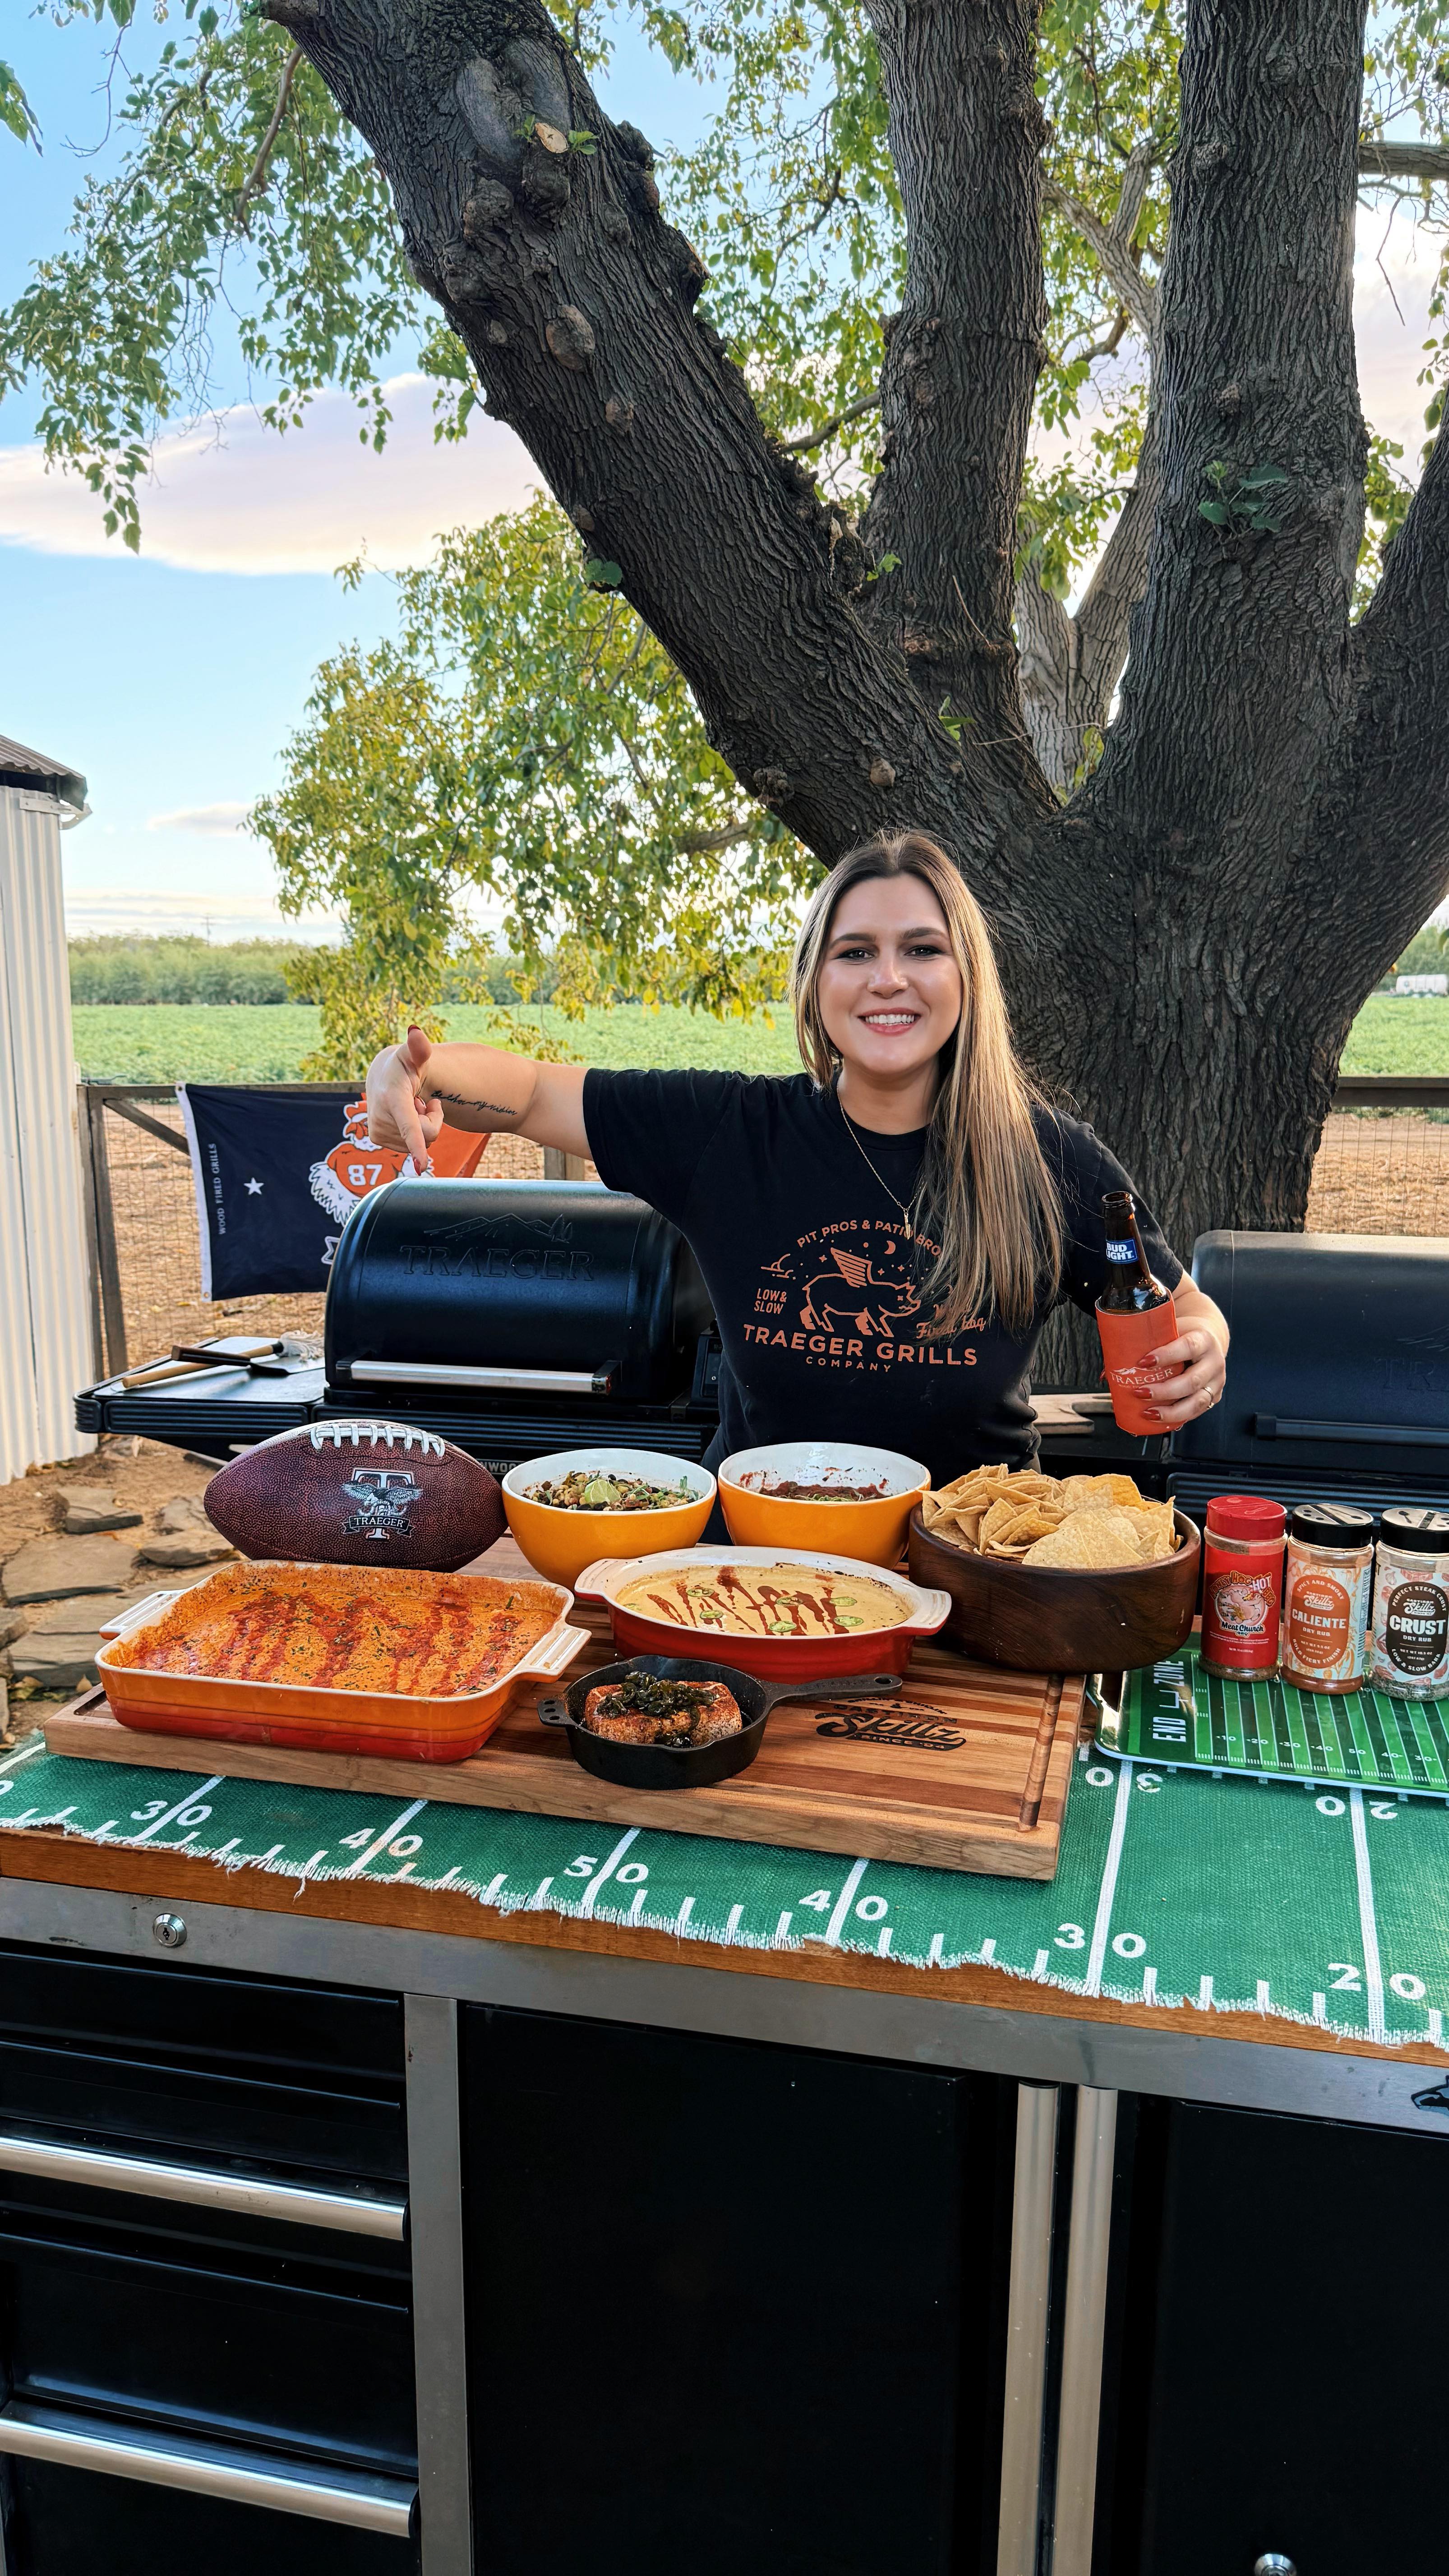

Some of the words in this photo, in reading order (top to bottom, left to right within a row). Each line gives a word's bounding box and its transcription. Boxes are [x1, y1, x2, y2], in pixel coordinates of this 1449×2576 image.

[208, 1143, 220, 1174] GRILLS
[347, 1164, 383, 1186] 87
[213, 1177, 224, 1204] FIRED
[217, 1207, 226, 1235] WOOD
[797, 1230, 817, 1248] PIT
[821, 1220, 858, 1236] PROS
[862, 1220, 871, 1230] &
[1107, 1242, 1127, 1252] BUD
[400, 1245, 594, 1281] TRAEGER
[754, 1300, 784, 1314] SLOW
[743, 1323, 863, 1357] TRAEGER
[877, 1342, 977, 1366] GRILLS
[806, 1356, 891, 1372] COMPANY
[1109, 1368, 1173, 1385] TRAEGER
[354, 1517, 403, 1528] TRAEGER
[1252, 1576, 1271, 1591] HOT
[1297, 1580, 1311, 1593] SPICY
[1326, 1582, 1345, 1601] SMOKY
[1303, 1595, 1335, 1609] Skillz
[1392, 1586, 1413, 1607] PERFECT
[1414, 1585, 1437, 1595] STEAK
[1292, 1608, 1347, 1629] CALIENTE
[1403, 1601, 1436, 1615] Skillz
[1221, 1621, 1239, 1631] Meat
[1239, 1623, 1264, 1632] Church
[1302, 1627, 1315, 1635] DRY
[1316, 1629, 1331, 1637] RUB
[1389, 1615, 1446, 1635] CRUST
[1302, 1654, 1321, 1664] FIERY
[1322, 1647, 1342, 1664] FINISH
[1392, 1648, 1402, 1662] LOW
[1427, 1653, 1441, 1669] BARK
[1153, 1661, 1185, 1687] ZONE
[814, 1712, 967, 1745] Skillz
[1152, 1716, 1186, 1743] END
[130, 1800, 213, 1827] 30
[338, 1828, 424, 1857] 40
[563, 1855, 649, 1884] 50
[798, 1890, 889, 1922] 40
[1053, 1923, 1147, 1958] 30
[1327, 1963, 1426, 2001] 20
